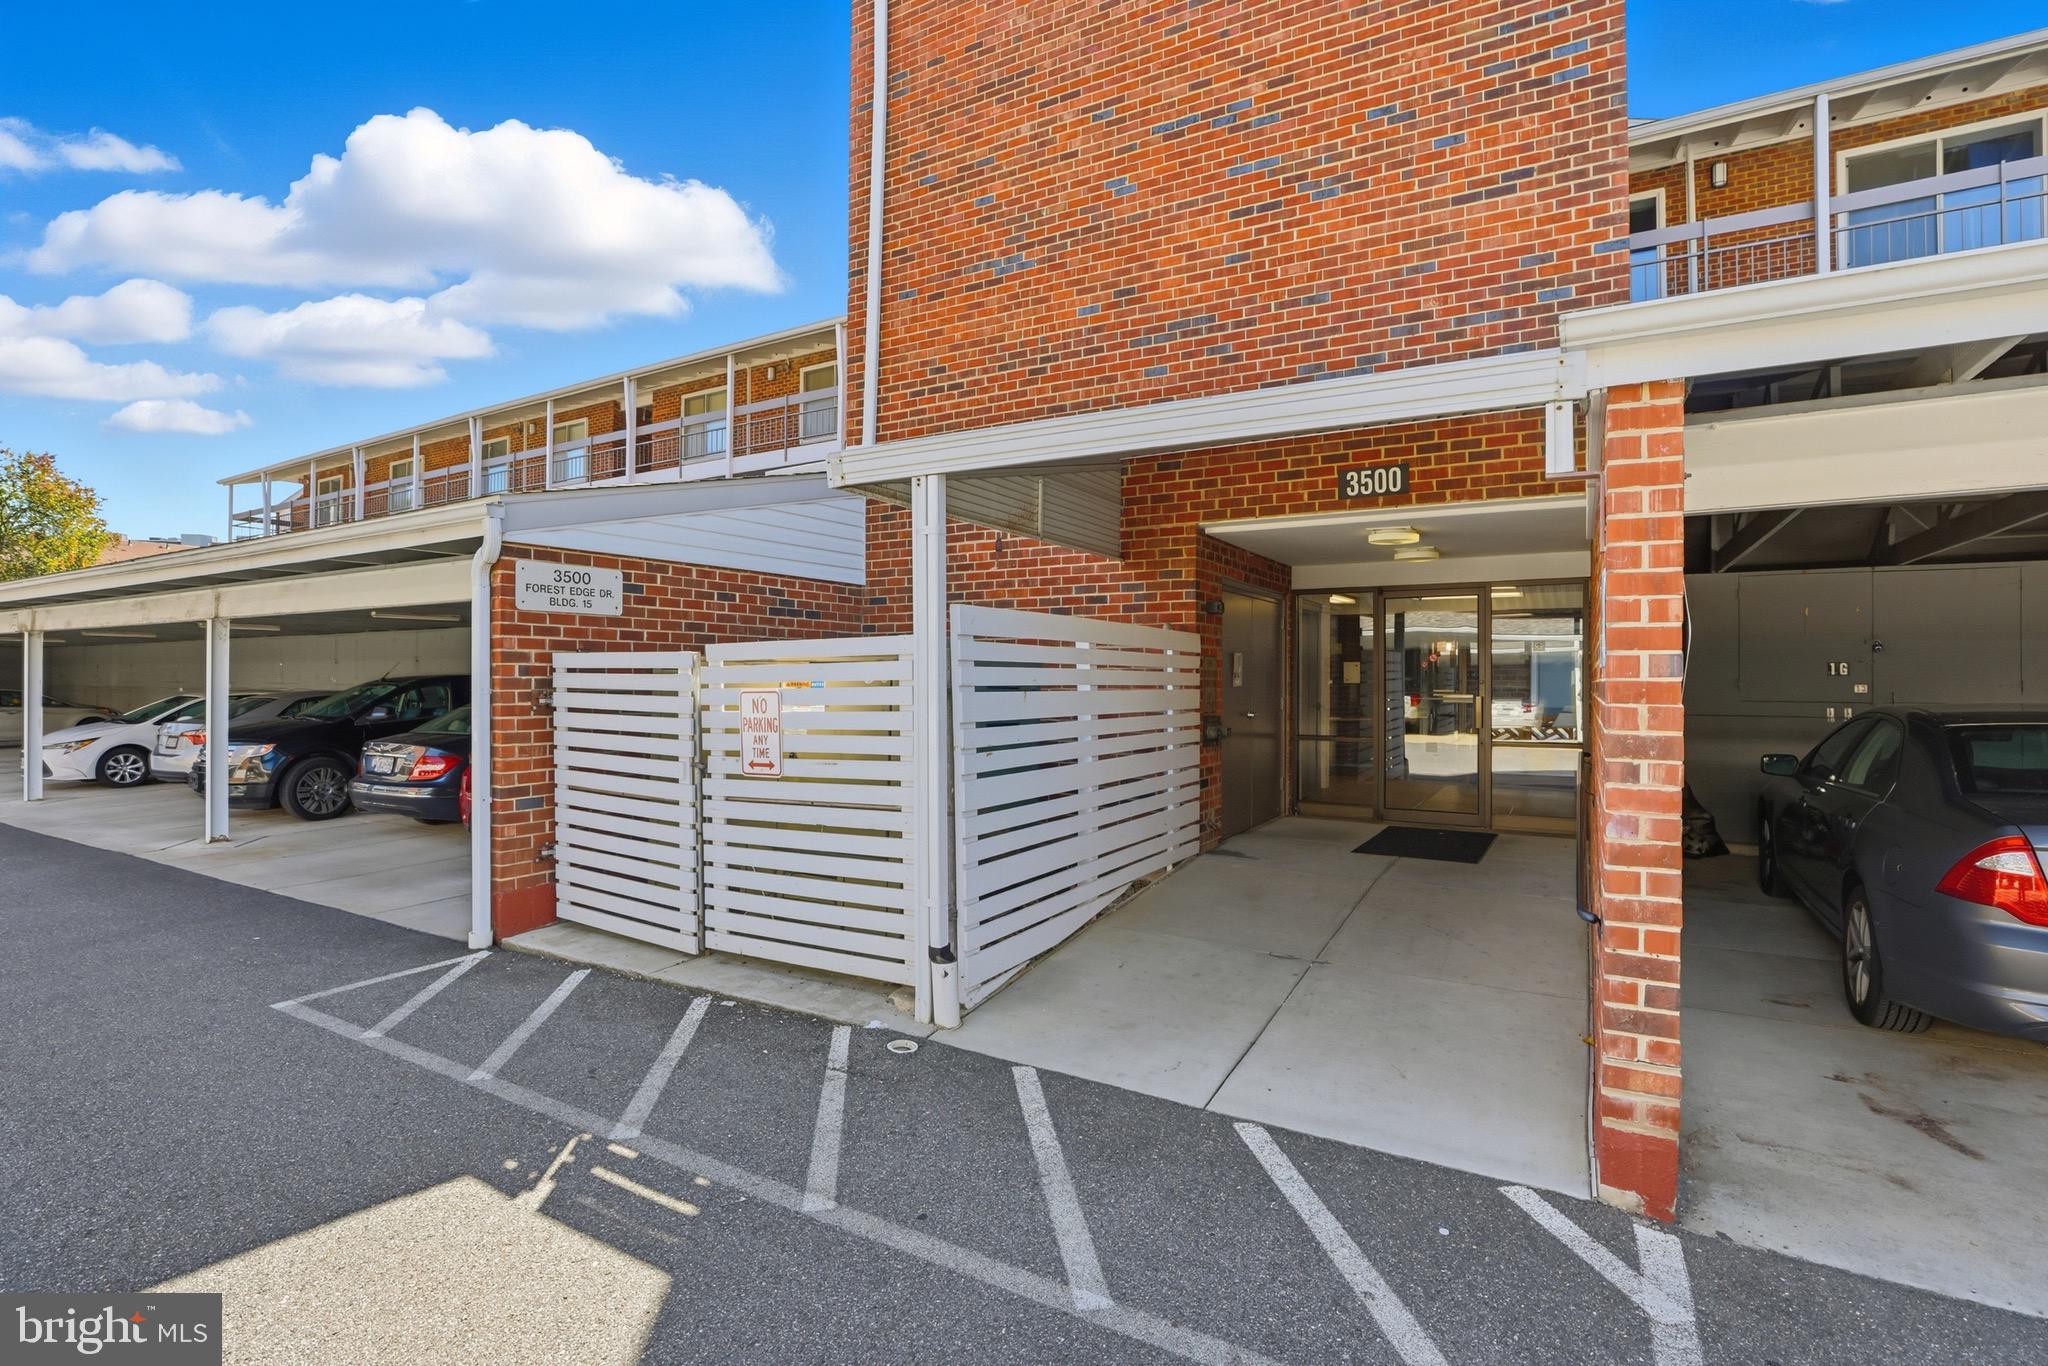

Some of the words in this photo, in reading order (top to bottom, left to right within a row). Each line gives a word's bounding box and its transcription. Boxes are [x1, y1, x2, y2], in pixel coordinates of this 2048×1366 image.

[1346, 466, 1402, 497] 3500
[553, 569, 592, 585] 3500
[525, 583, 566, 595] FOREST
[569, 586, 596, 597] EDGE
[599, 588, 615, 599] DR.
[549, 596, 579, 608] BLDG.
[583, 599, 593, 609] 15
[751, 697, 768, 714] NO
[742, 716, 778, 733] PARKING
[752, 735, 769, 746] ANY
[751, 747, 770, 759] TIME
